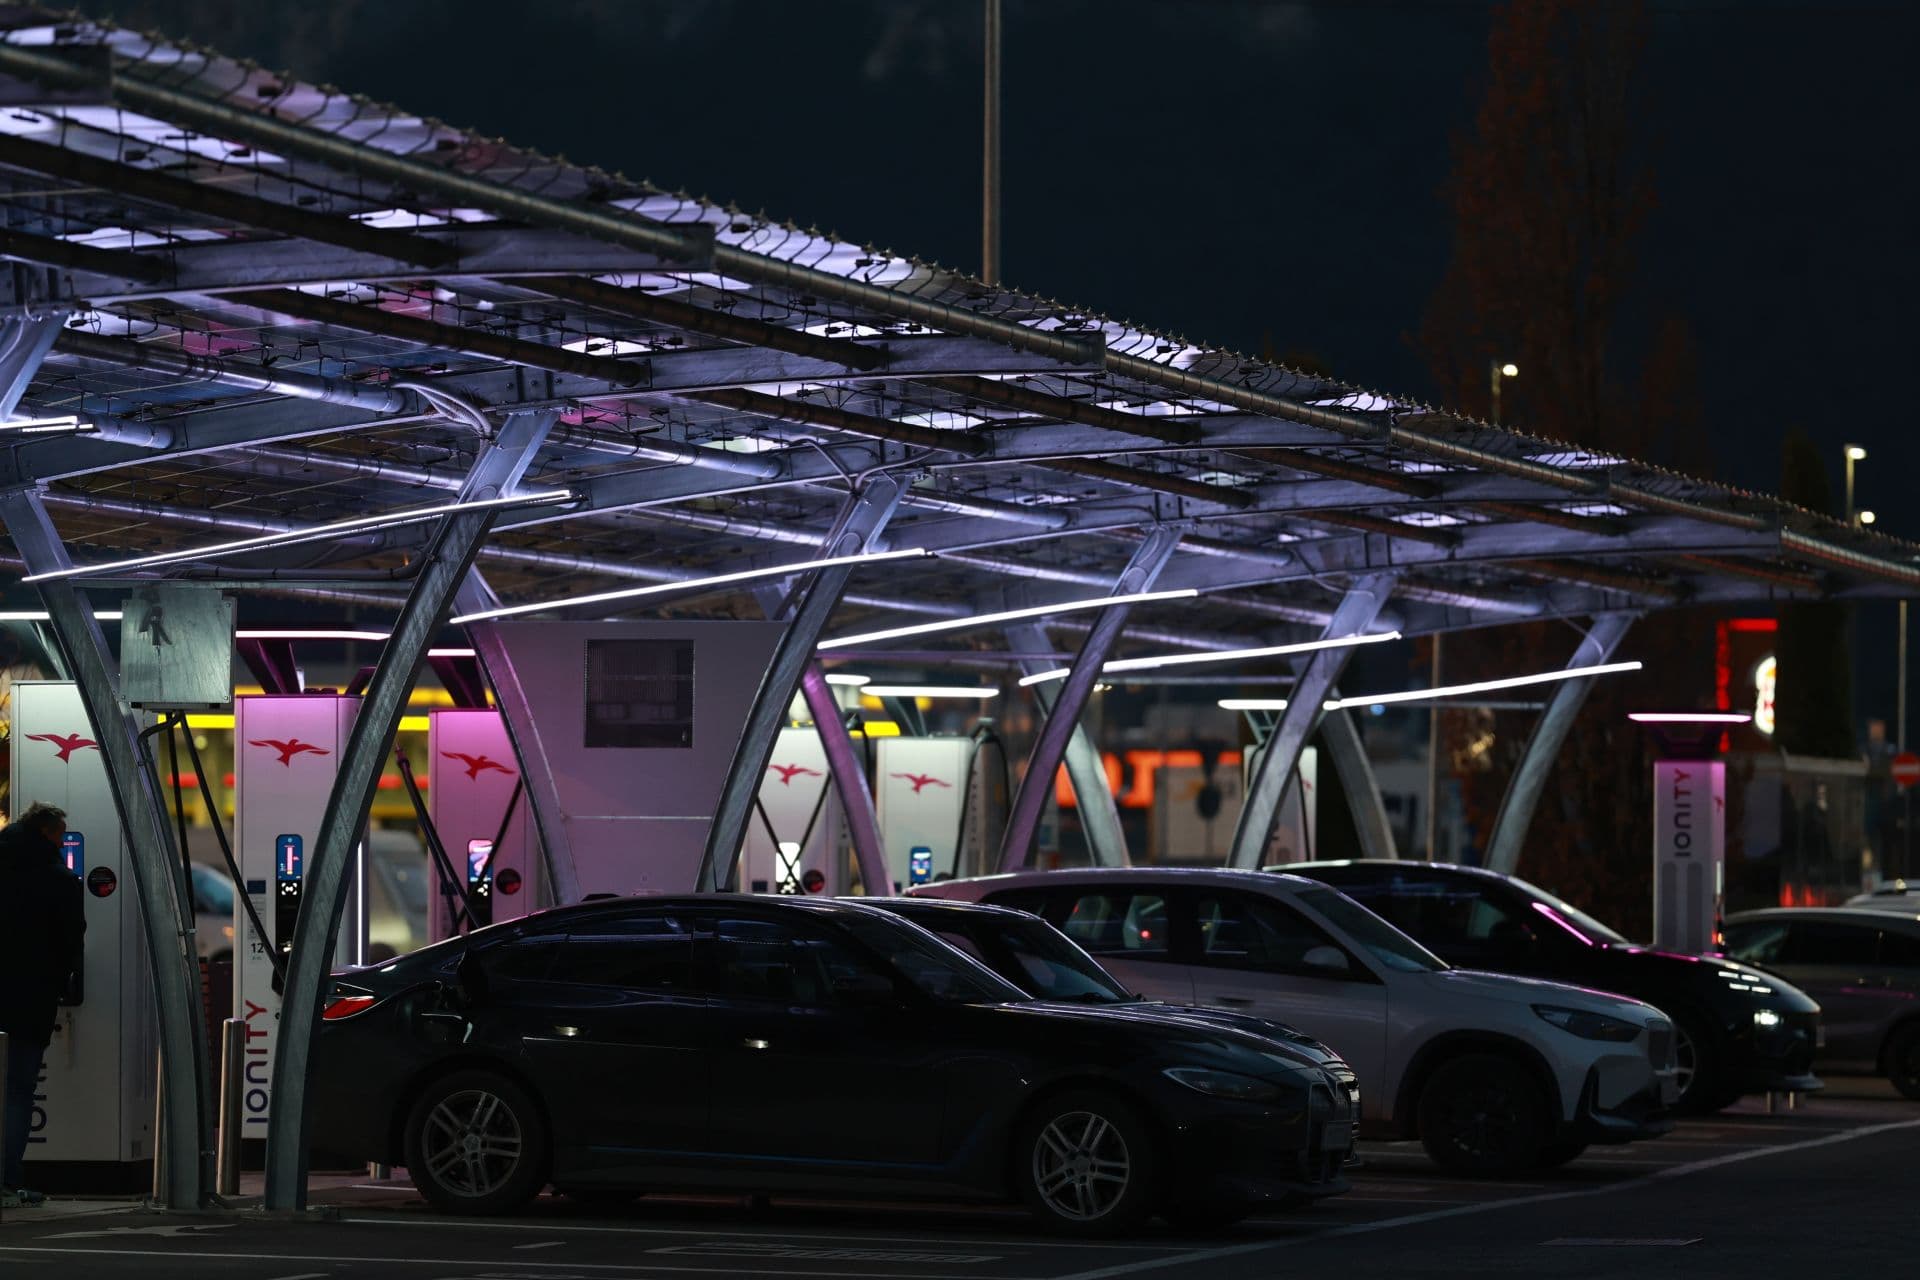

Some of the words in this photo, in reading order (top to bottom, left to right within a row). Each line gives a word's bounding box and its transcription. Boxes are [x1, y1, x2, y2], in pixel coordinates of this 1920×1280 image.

[1673, 768, 1691, 857] IONITY
[251, 942, 264, 954] 12
[245, 1000, 268, 1123] IONITY
